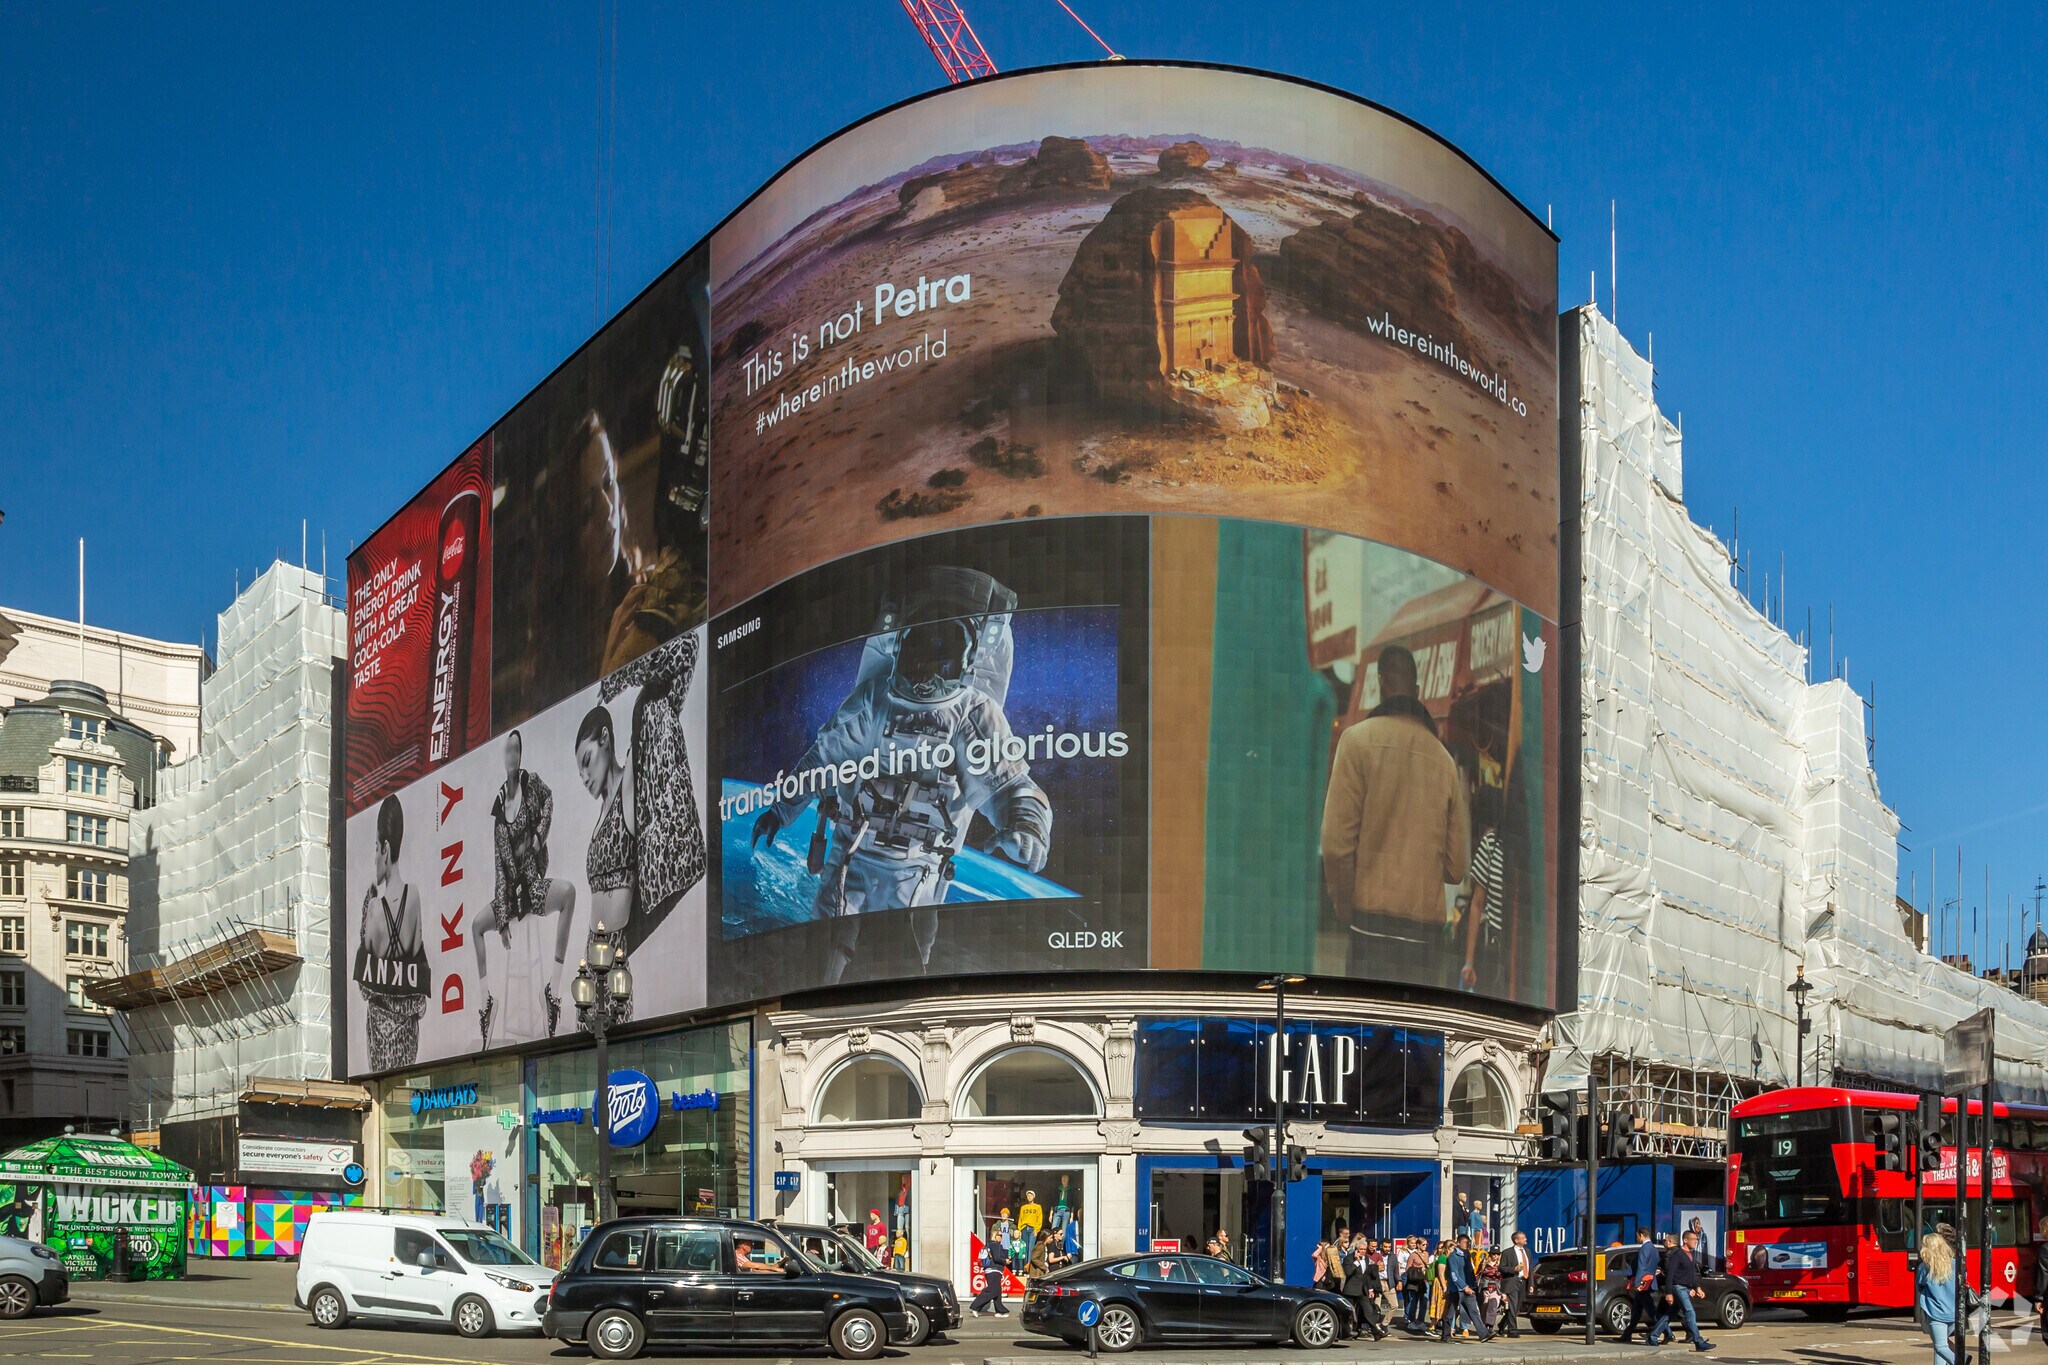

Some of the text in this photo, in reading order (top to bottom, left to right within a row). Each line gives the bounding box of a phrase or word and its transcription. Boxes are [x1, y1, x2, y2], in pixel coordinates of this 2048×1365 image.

[743, 273, 971, 396] This is not Petra
[755, 328, 947, 436] #whereintheworld
[1366, 311, 1527, 417] whereintheworld.co
[354, 557, 398, 606] THE ONLY
[354, 559, 422, 628] ENERGY DRINK
[354, 583, 419, 648] WITH A GREAT
[717, 616, 761, 650] SAMSUNG
[354, 617, 406, 669] COCA-COLA
[354, 656, 381, 690] TASTE
[429, 591, 454, 762] ENERGY
[718, 724, 1129, 823] transformed into glorious
[441, 781, 464, 1014] DKNY
[1048, 931, 1124, 950] QLED 8K
[362, 953, 418, 988] DKNY
[1268, 1032, 1355, 1105] GAP
[422, 1083, 478, 1110] BARCLAYS
[75, 1150, 153, 1166] WICKED
[266, 1152, 302, 1160] everyone's
[303, 1153, 323, 1161] safety
[1778, 1140, 1792, 1156] 19
[85, 1168, 107, 1176] BEST
[109, 1169, 137, 1178] SHOW
[139, 1171, 149, 1179] IN
[55, 1183, 176, 1224] WICKED
[128, 1240, 152, 1252] 100
[1535, 1227, 1566, 1254] GAP
